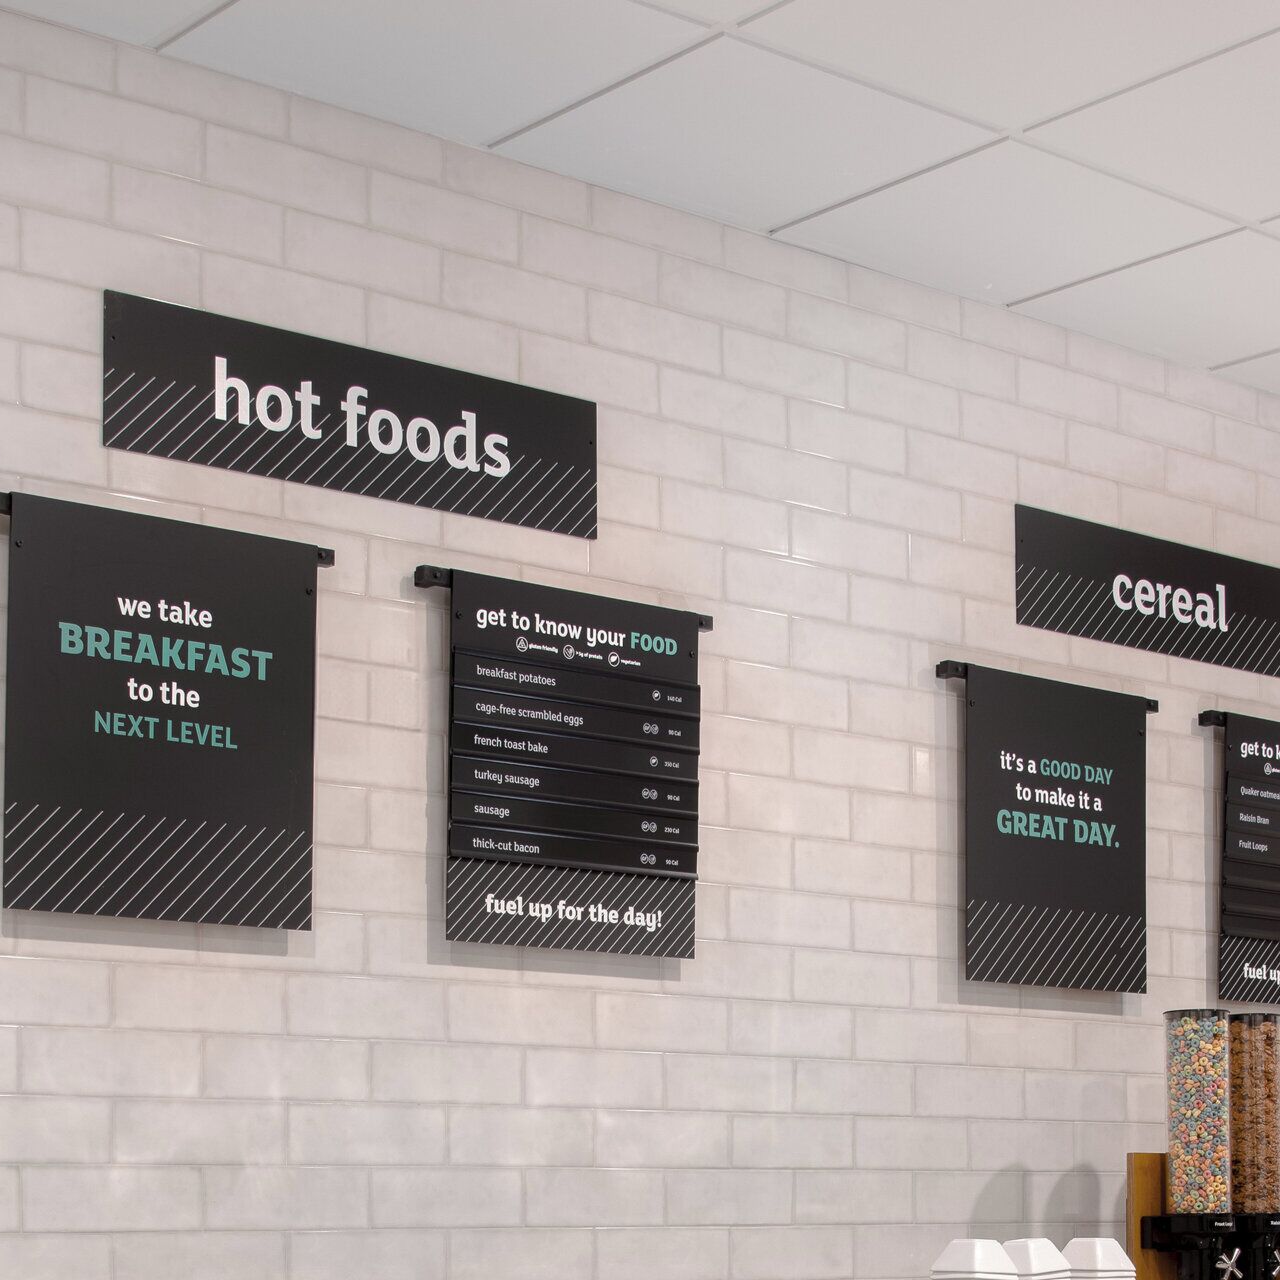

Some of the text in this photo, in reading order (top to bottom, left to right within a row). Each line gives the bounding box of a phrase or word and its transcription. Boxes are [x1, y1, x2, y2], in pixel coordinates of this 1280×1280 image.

[214, 356, 511, 477] hot foods
[118, 597, 213, 628] we take
[1112, 574, 1228, 632] cereal
[477, 609, 678, 655] get to know your FOOD
[58, 622, 273, 681] BREAKFAST
[477, 665, 556, 686] breakfast potatoes
[128, 678, 200, 707] to the
[475, 701, 584, 726] cage-free scrambled eggs
[94, 711, 237, 749] NEXT LEVEL
[474, 734, 548, 753] french toast bake
[1241, 741, 1259, 758] get
[1262, 744, 1273, 759] to
[474, 769, 540, 788] turkey sausage
[1028, 759, 1036, 774] a
[1040, 758, 1080, 780] GOOD
[1084, 765, 1113, 785] DAY
[1015, 782, 1102, 812] to make it a
[1241, 786, 1280, 800] Quaker oatmeal
[474, 805, 510, 817] sausage
[1240, 813, 1269, 825] Raisin Bran
[997, 809, 1120, 849] GREAT DAY.
[472, 837, 540, 854] thick-cut bacon
[1239, 839, 1267, 852] Fruit Loops
[485, 894, 663, 932] fuel up for the day!
[1243, 963, 1267, 980] fuel
